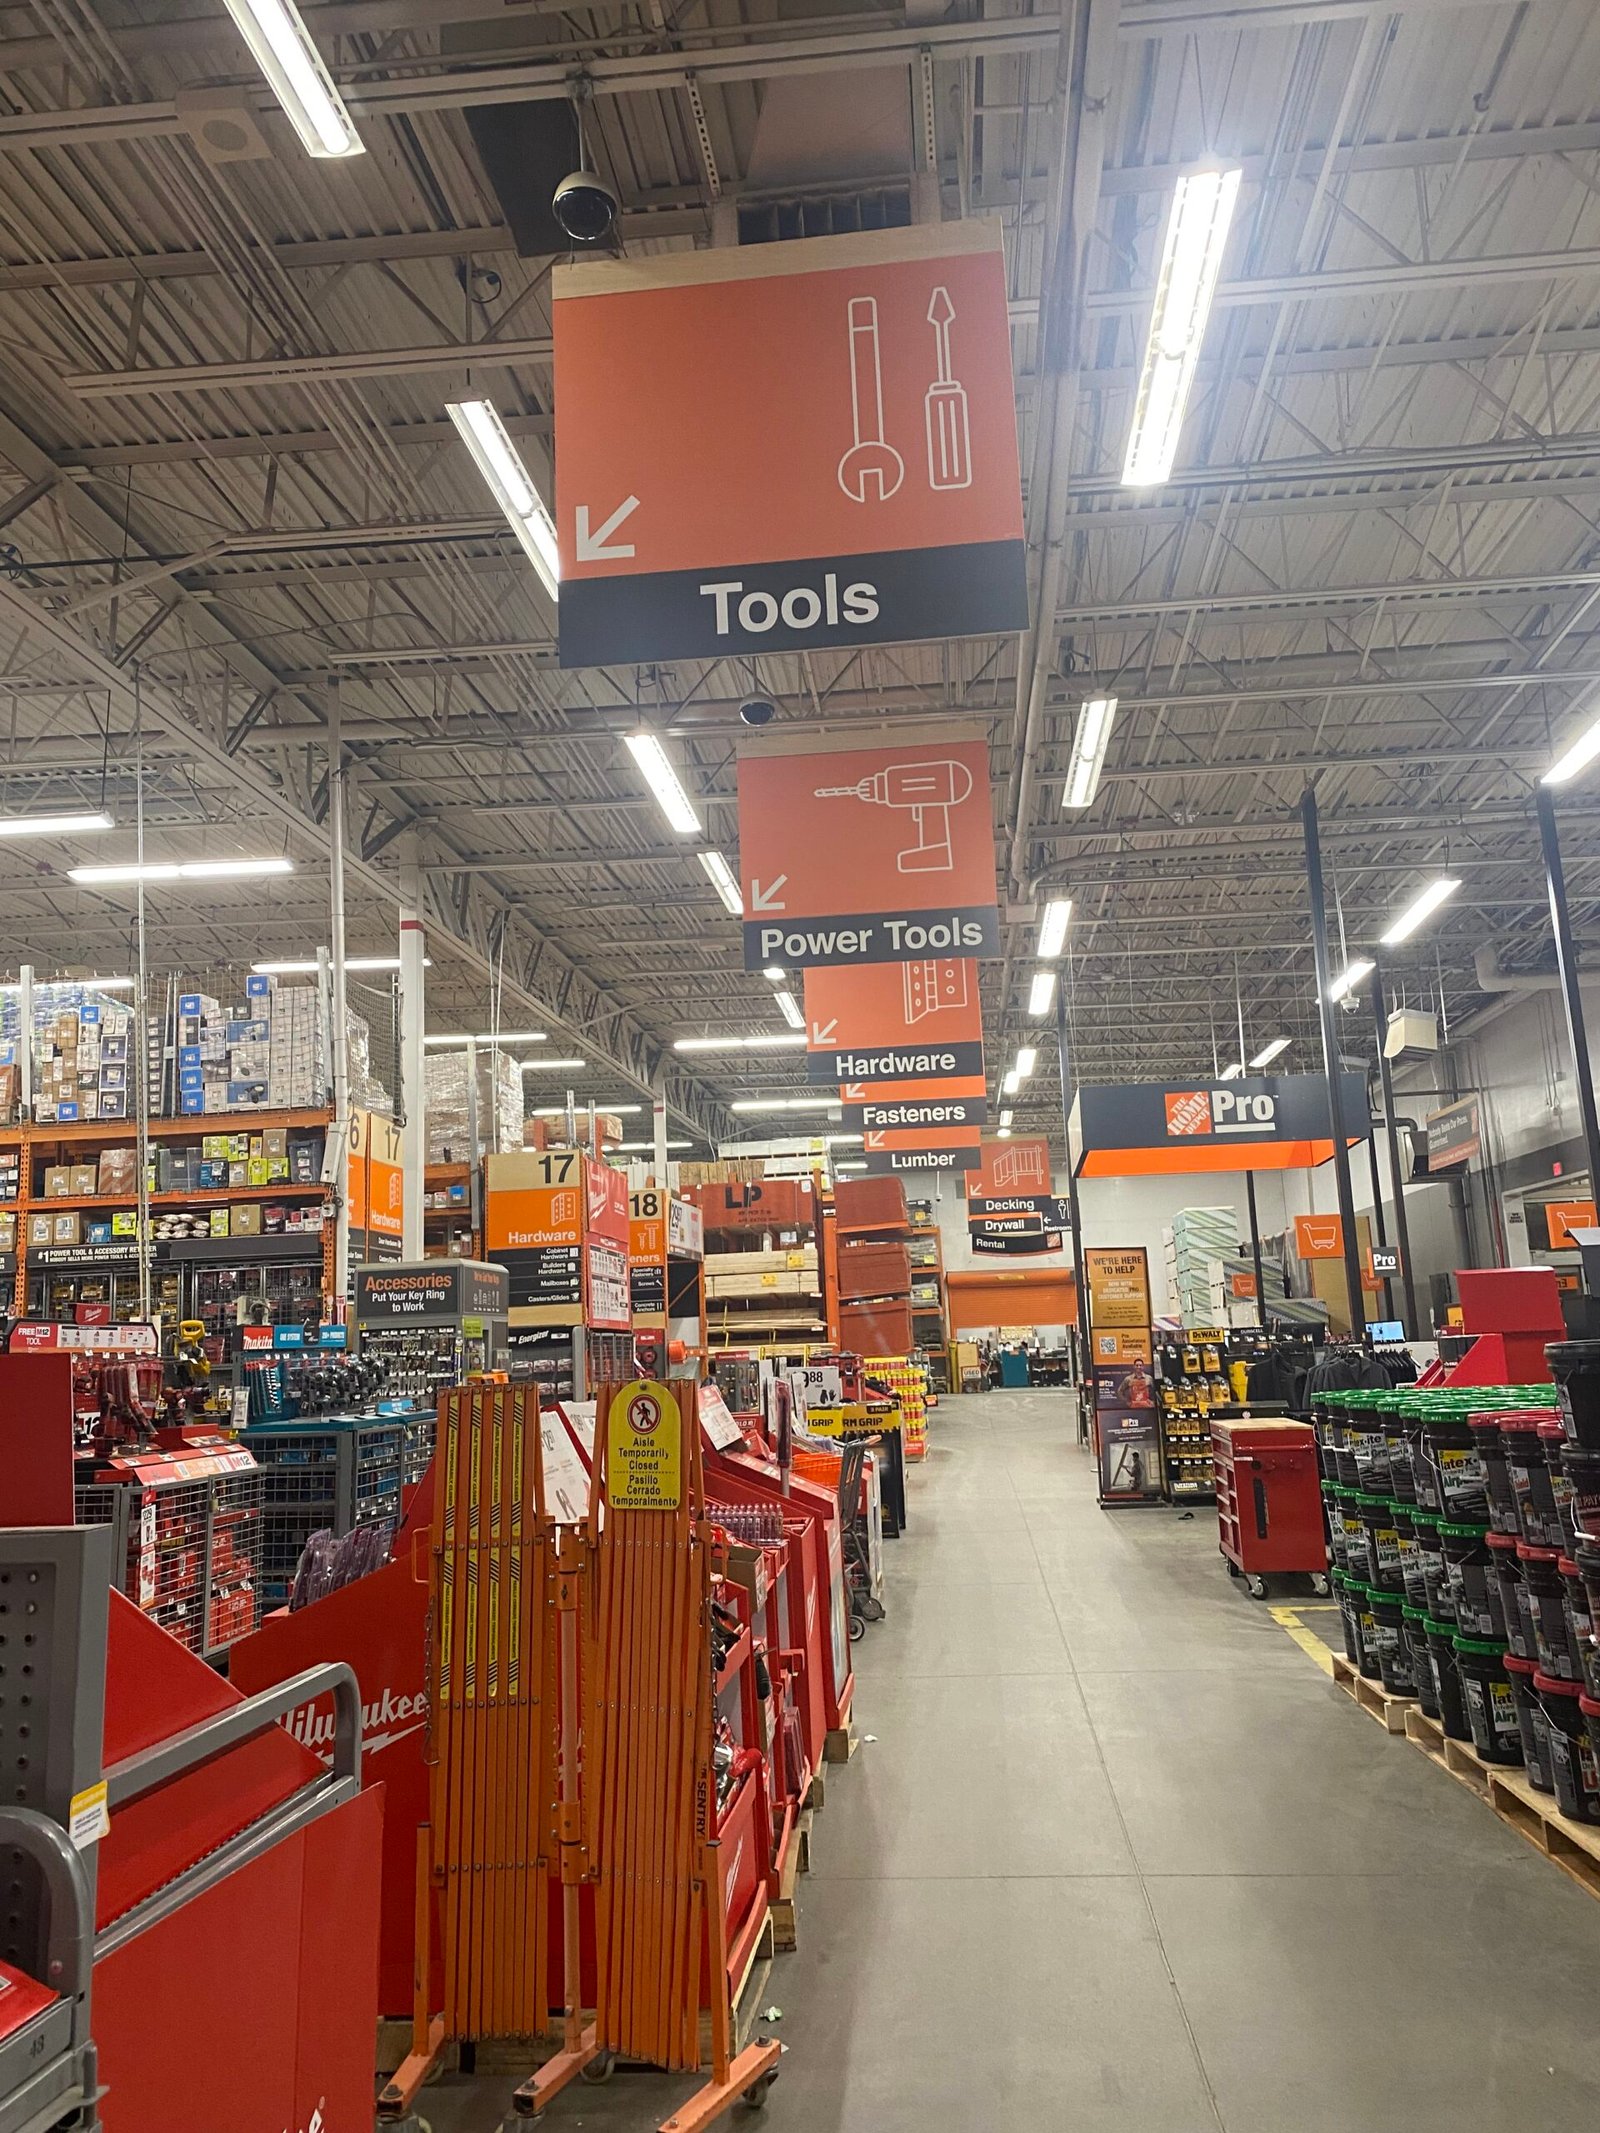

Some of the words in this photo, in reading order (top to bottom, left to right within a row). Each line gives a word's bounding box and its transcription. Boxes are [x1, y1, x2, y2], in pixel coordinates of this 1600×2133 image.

[700, 573, 880, 635] Tools
[761, 927, 873, 958] Power
[883, 917, 983, 950] Tools
[836, 1052, 956, 1077] Hardware
[1167, 1091, 1209, 1135] HOME
[1170, 1096, 1188, 1115] THE
[1211, 1090, 1275, 1122] Pro
[863, 1104, 966, 1125] Fasteners
[1185, 1107, 1210, 1135] DEPOT
[385, 1125, 401, 1161] 17
[891, 1152, 956, 1169] Lumber
[538, 1154, 575, 1184] 17
[629, 1193, 659, 1217] 18
[725, 1186, 762, 1209] LP
[985, 1199, 1035, 1211] Decking
[371, 1209, 401, 1229] Hardware
[985, 1219, 1025, 1232] Drywall
[508, 1229, 576, 1245] Hardware
[976, 1238, 1006, 1249] Rental
[38, 1250, 49, 1263] #1
[94, 1247, 129, 1255] ACCESSORY
[1093, 1257, 1119, 1266] WE'RE
[1121, 1256, 1142, 1265] HERE
[1373, 1253, 1396, 1267] Pro
[1103, 1266, 1113, 1275] TO
[1115, 1266, 1135, 1274] HELP
[365, 1273, 452, 1291] Accessories
[372, 1293, 386, 1302] Put
[388, 1292, 407, 1301] Your
[409, 1290, 424, 1301] Key
[426, 1289, 445, 1301] Ring
[392, 1303, 400, 1312] to
[402, 1302, 425, 1312] Work
[18, 1328, 36, 1336] FREE
[36, 1327, 50, 1337] M12
[518, 1330, 549, 1346] Energizer
[26, 1337, 41, 1345] TOOL
[812, 1418, 834, 1427] GRIP
[860, 1417, 883, 1426] GRIP
[633, 1438, 655, 1447] Aisle
[618, 1448, 669, 1460] Temporarily
[232, 1456, 251, 1469] M12
[629, 1461, 659, 1470] Closed
[629, 1475, 658, 1485] Pasillo
[626, 1485, 661, 1495] Cerrado
[611, 1495, 677, 1507] Temporalmente
[274, 1688, 429, 1748] ilwukee
[696, 1781, 706, 1836] SENTRY
